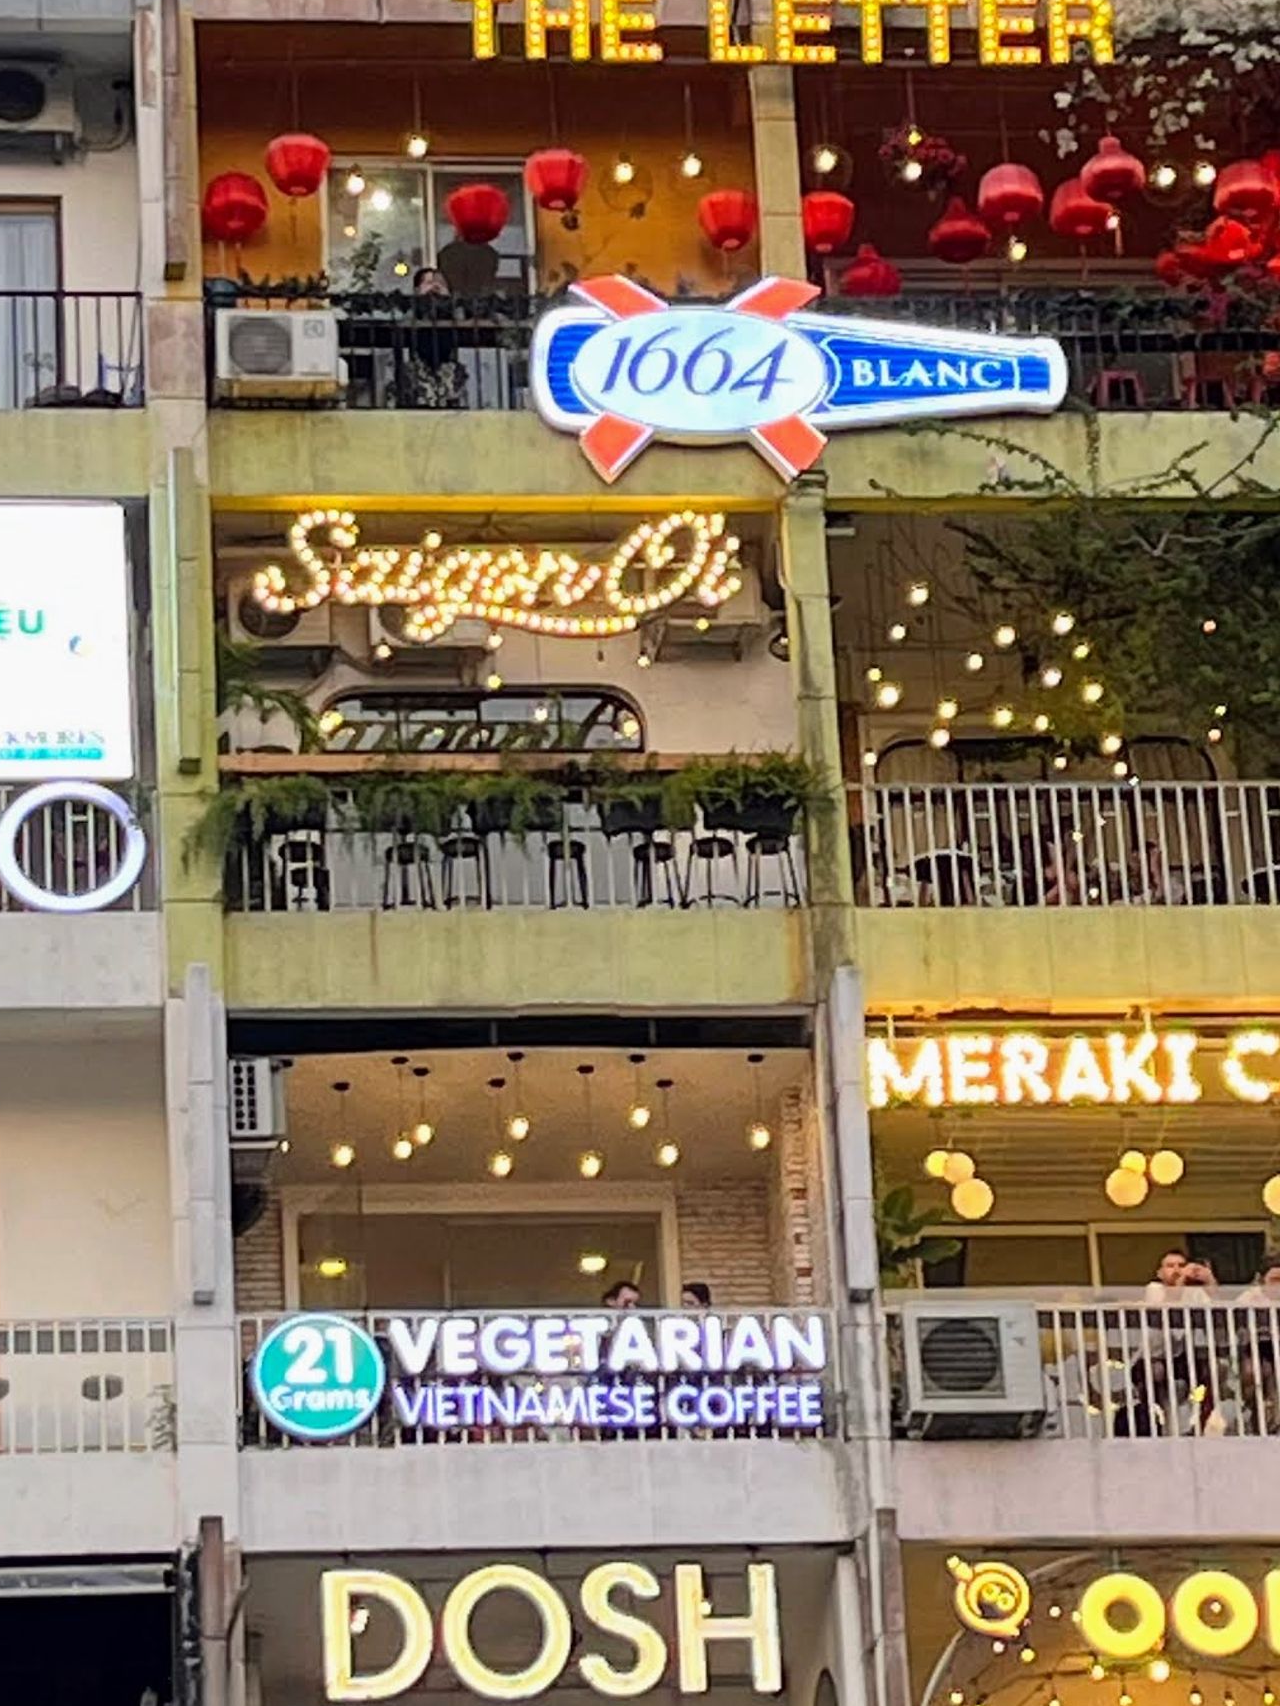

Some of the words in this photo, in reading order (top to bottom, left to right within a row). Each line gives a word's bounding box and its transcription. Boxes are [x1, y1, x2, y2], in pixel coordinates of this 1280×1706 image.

[599, 333, 791, 402] 1664
[851, 356, 1003, 391] BLANC
[867, 1030, 1203, 1108] MERAKI
[284, 1326, 355, 1384] 21
[390, 1316, 826, 1374] VEGETARIAN
[270, 1386, 371, 1412] Grams
[395, 1385, 655, 1426] VIETNAMESE
[666, 1385, 823, 1425] COFFEE
[320, 1562, 782, 1704] DOSH
